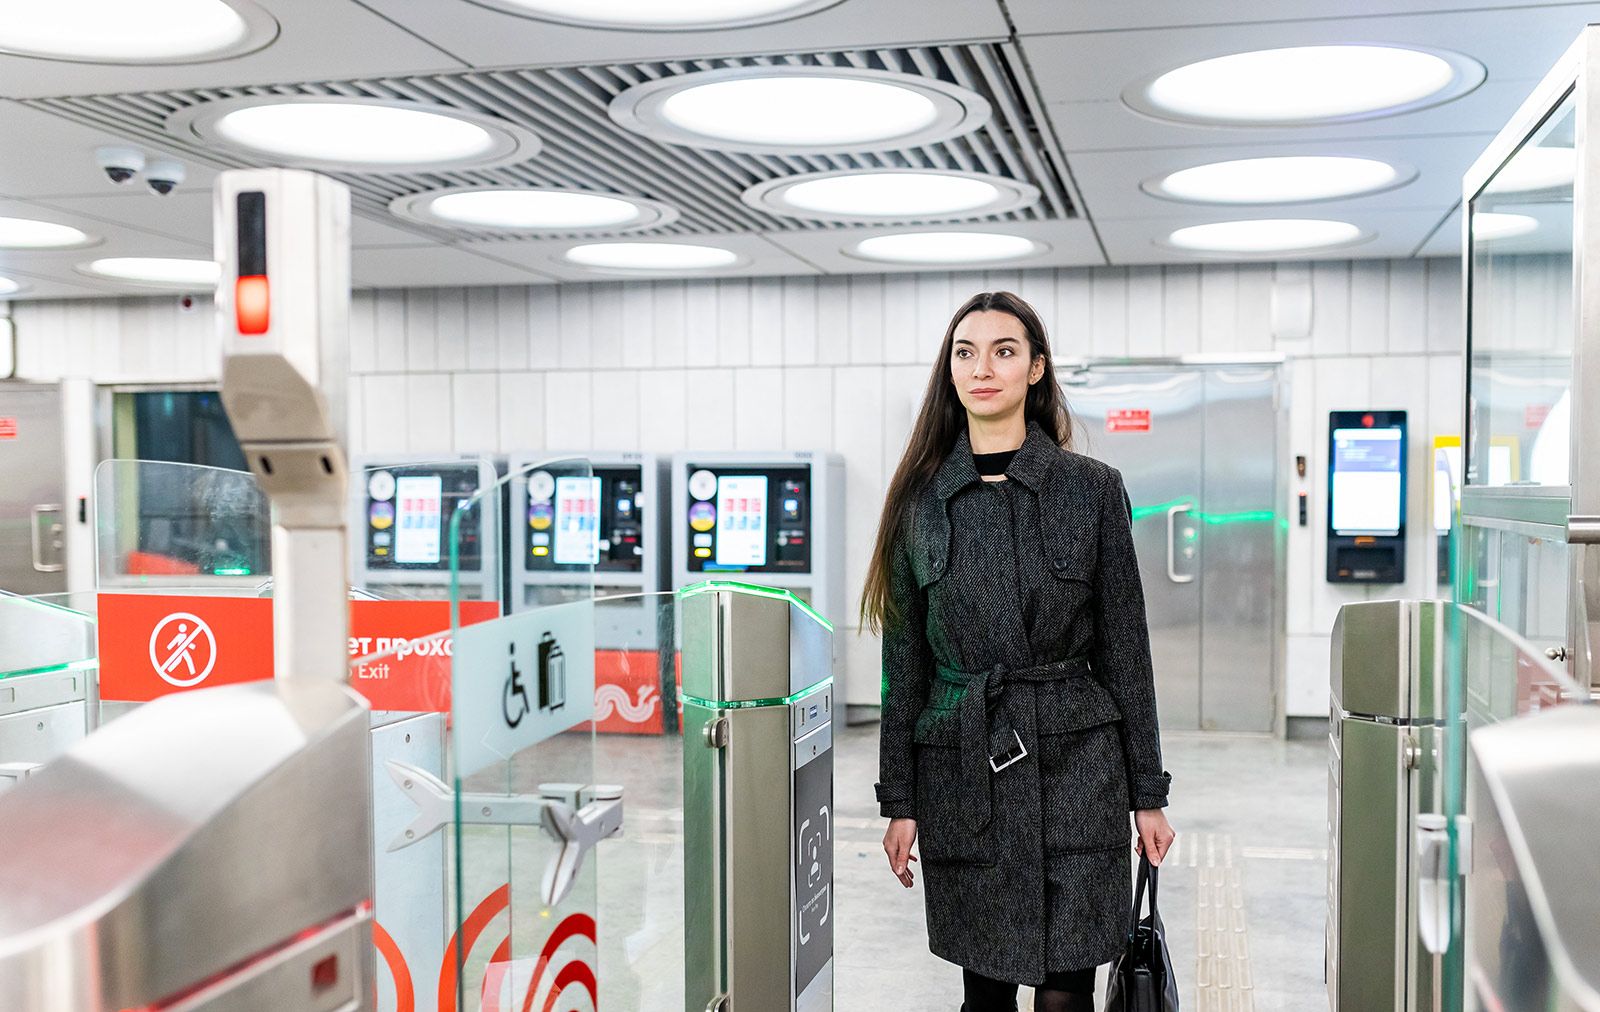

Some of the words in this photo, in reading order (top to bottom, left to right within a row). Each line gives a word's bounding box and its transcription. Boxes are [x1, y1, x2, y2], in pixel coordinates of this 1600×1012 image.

[348, 637, 372, 655] ет
[376, 637, 453, 661] прохо
[358, 663, 390, 679] Exit
